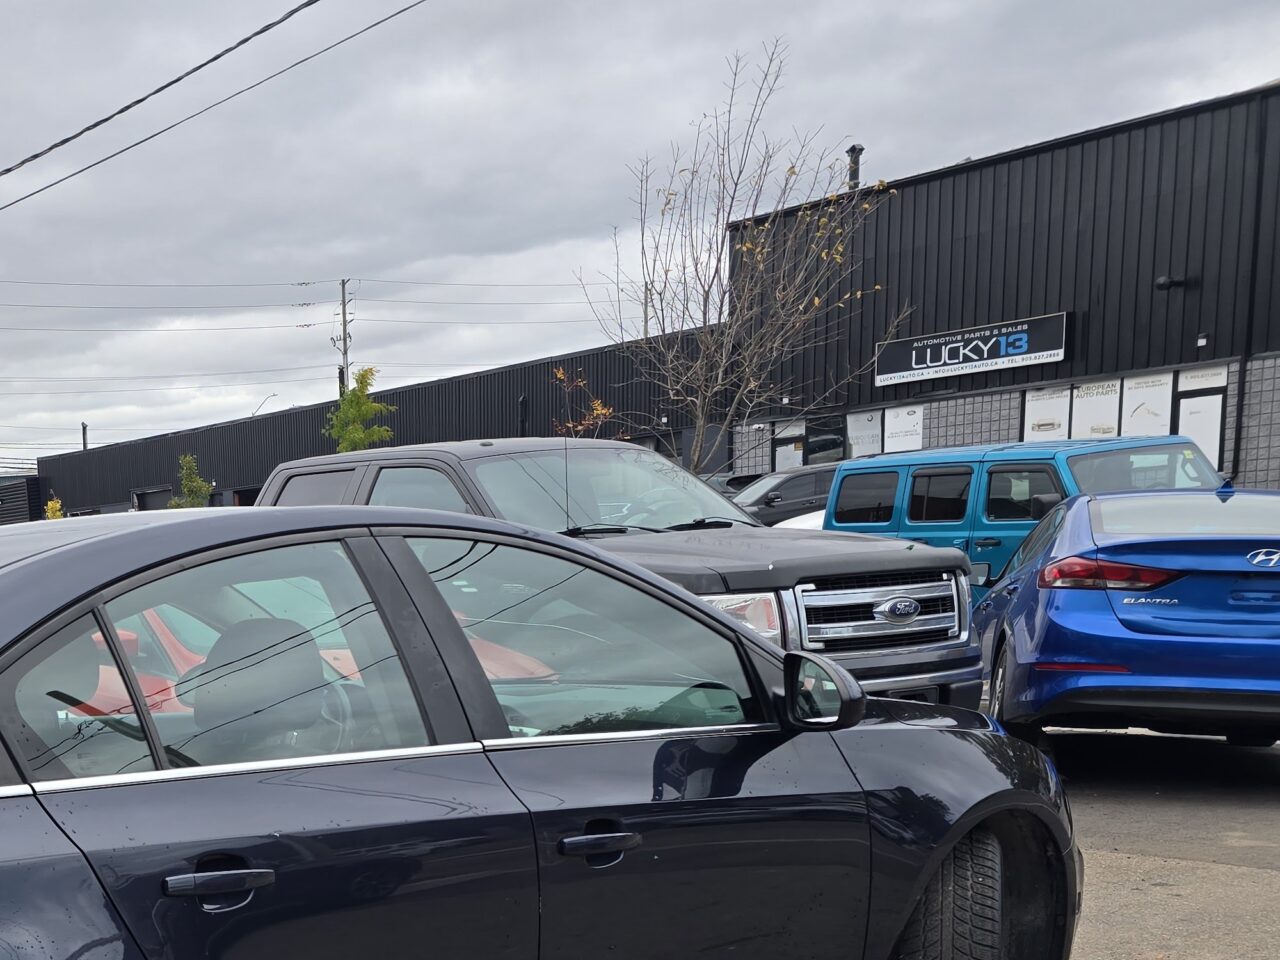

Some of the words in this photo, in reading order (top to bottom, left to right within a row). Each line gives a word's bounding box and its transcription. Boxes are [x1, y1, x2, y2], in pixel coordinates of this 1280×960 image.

[913, 335, 962, 347] AUTOMOTIVE
[964, 331, 991, 340] PARTS
[1001, 324, 1028, 333] SALES
[1075, 391, 1094, 399] AUTO
[1095, 388, 1118, 397] PARTS
[895, 602, 915, 614] Ford
